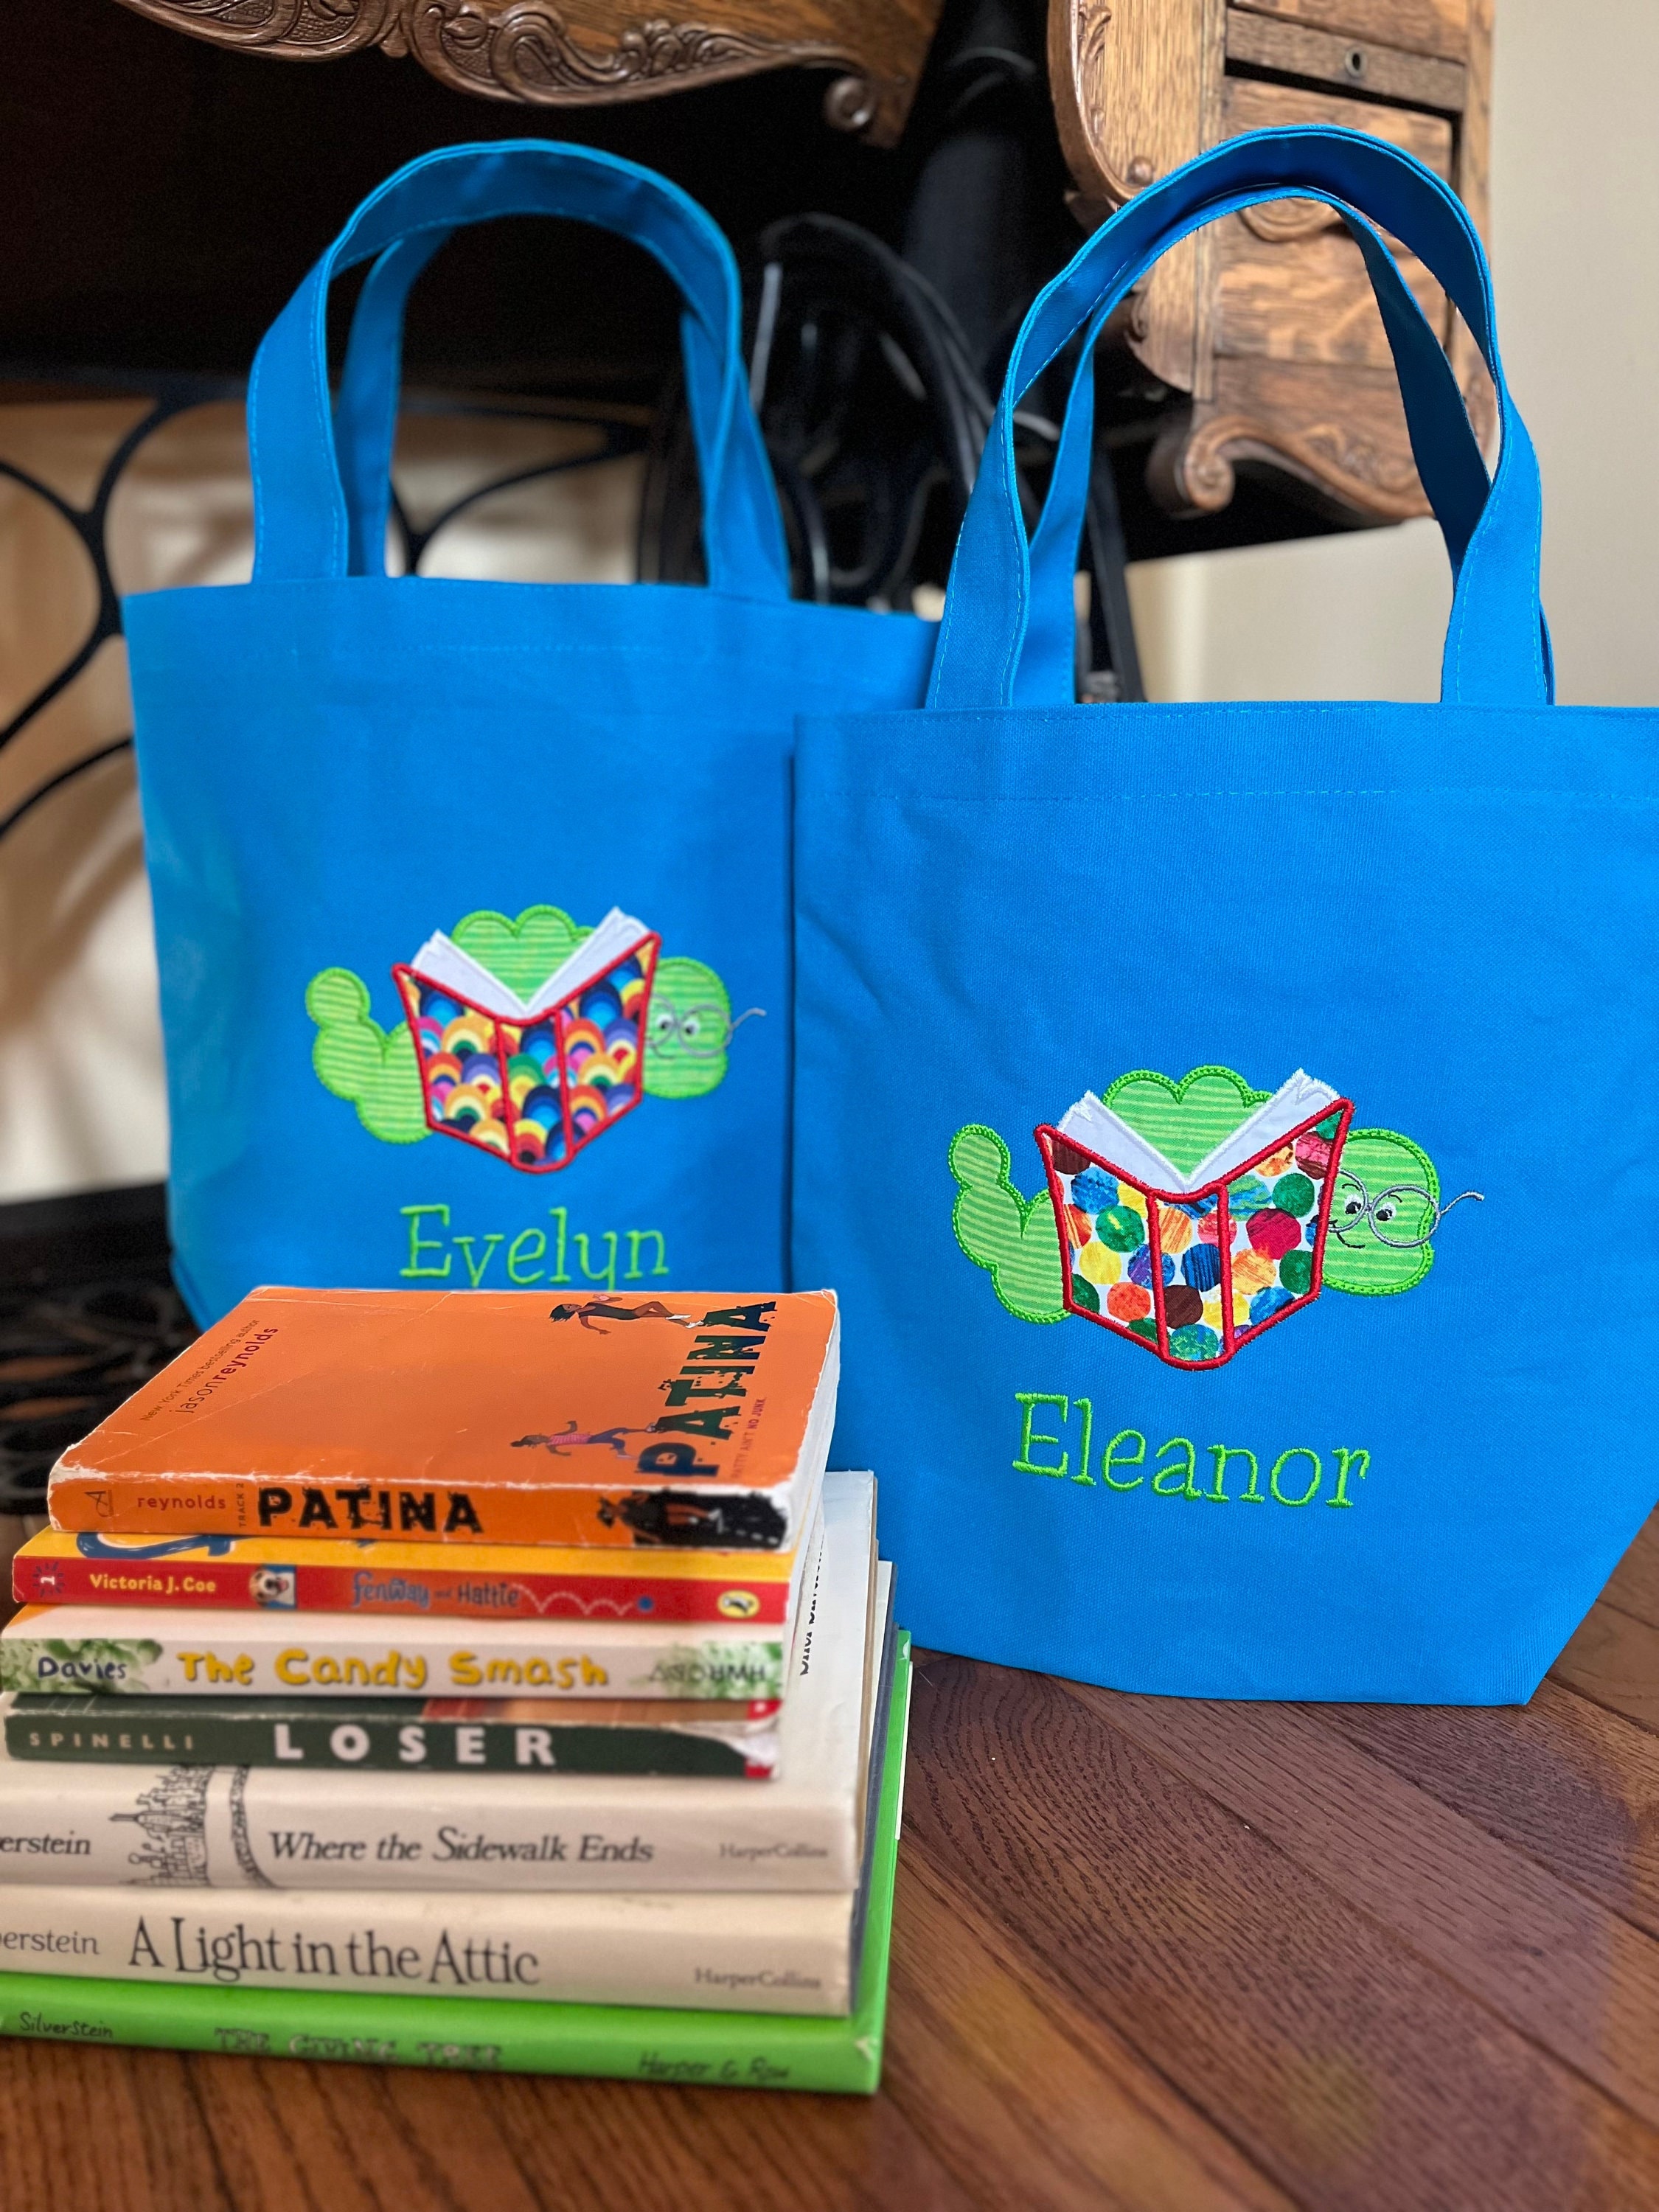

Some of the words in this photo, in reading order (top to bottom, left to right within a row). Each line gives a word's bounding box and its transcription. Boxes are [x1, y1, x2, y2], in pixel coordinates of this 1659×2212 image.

[399, 1203, 669, 1291] Evelyn
[140, 1405, 163, 1421] New
[159, 1389, 181, 1403] York
[177, 1370, 204, 1389] Times
[198, 1338, 241, 1370] bestselling
[236, 1319, 260, 1338] author
[634, 1301, 777, 1478] PATINA
[747, 1419, 759, 1429] NO
[1012, 1392, 1371, 1508] Eleanor
[137, 1495, 226, 1511] reynolds
[237, 1493, 246, 1528] TRACK
[257, 1484, 483, 1534] PATINA
[89, 1573, 164, 1592] Victoria
[166, 1577, 180, 1593] J.
[183, 1577, 217, 1593] Coe
[458, 1582, 519, 1607] Hattie
[38, 1656, 126, 1680] Davies
[177, 1651, 254, 1685] The
[274, 1648, 427, 1688] Candy
[448, 1651, 609, 1688] Smash
[29, 1731, 194, 1750] SPINELLI
[275, 1724, 555, 1766] LOSER
[0, 1830, 91, 1855] erstein
[269, 1831, 366, 1860] Where
[377, 1834, 422, 1860] the
[432, 1826, 566, 1862] Sidewalk
[577, 1835, 653, 1863] Ends
[720, 1843, 828, 1859] HarperCollins
[0, 1930, 100, 1955] erstein
[128, 1916, 165, 1967] A
[170, 1916, 286, 1982] Light
[292, 1932, 338, 1975] in
[347, 1930, 420, 1978] the
[428, 1929, 540, 1985] Attic
[695, 1967, 821, 1989] HarperCollins
[20, 2011, 113, 2039] Silverstein
[215, 2028, 270, 2053] THE
[289, 2034, 397, 2061] GIVING
[417, 2041, 502, 2067] TREE
